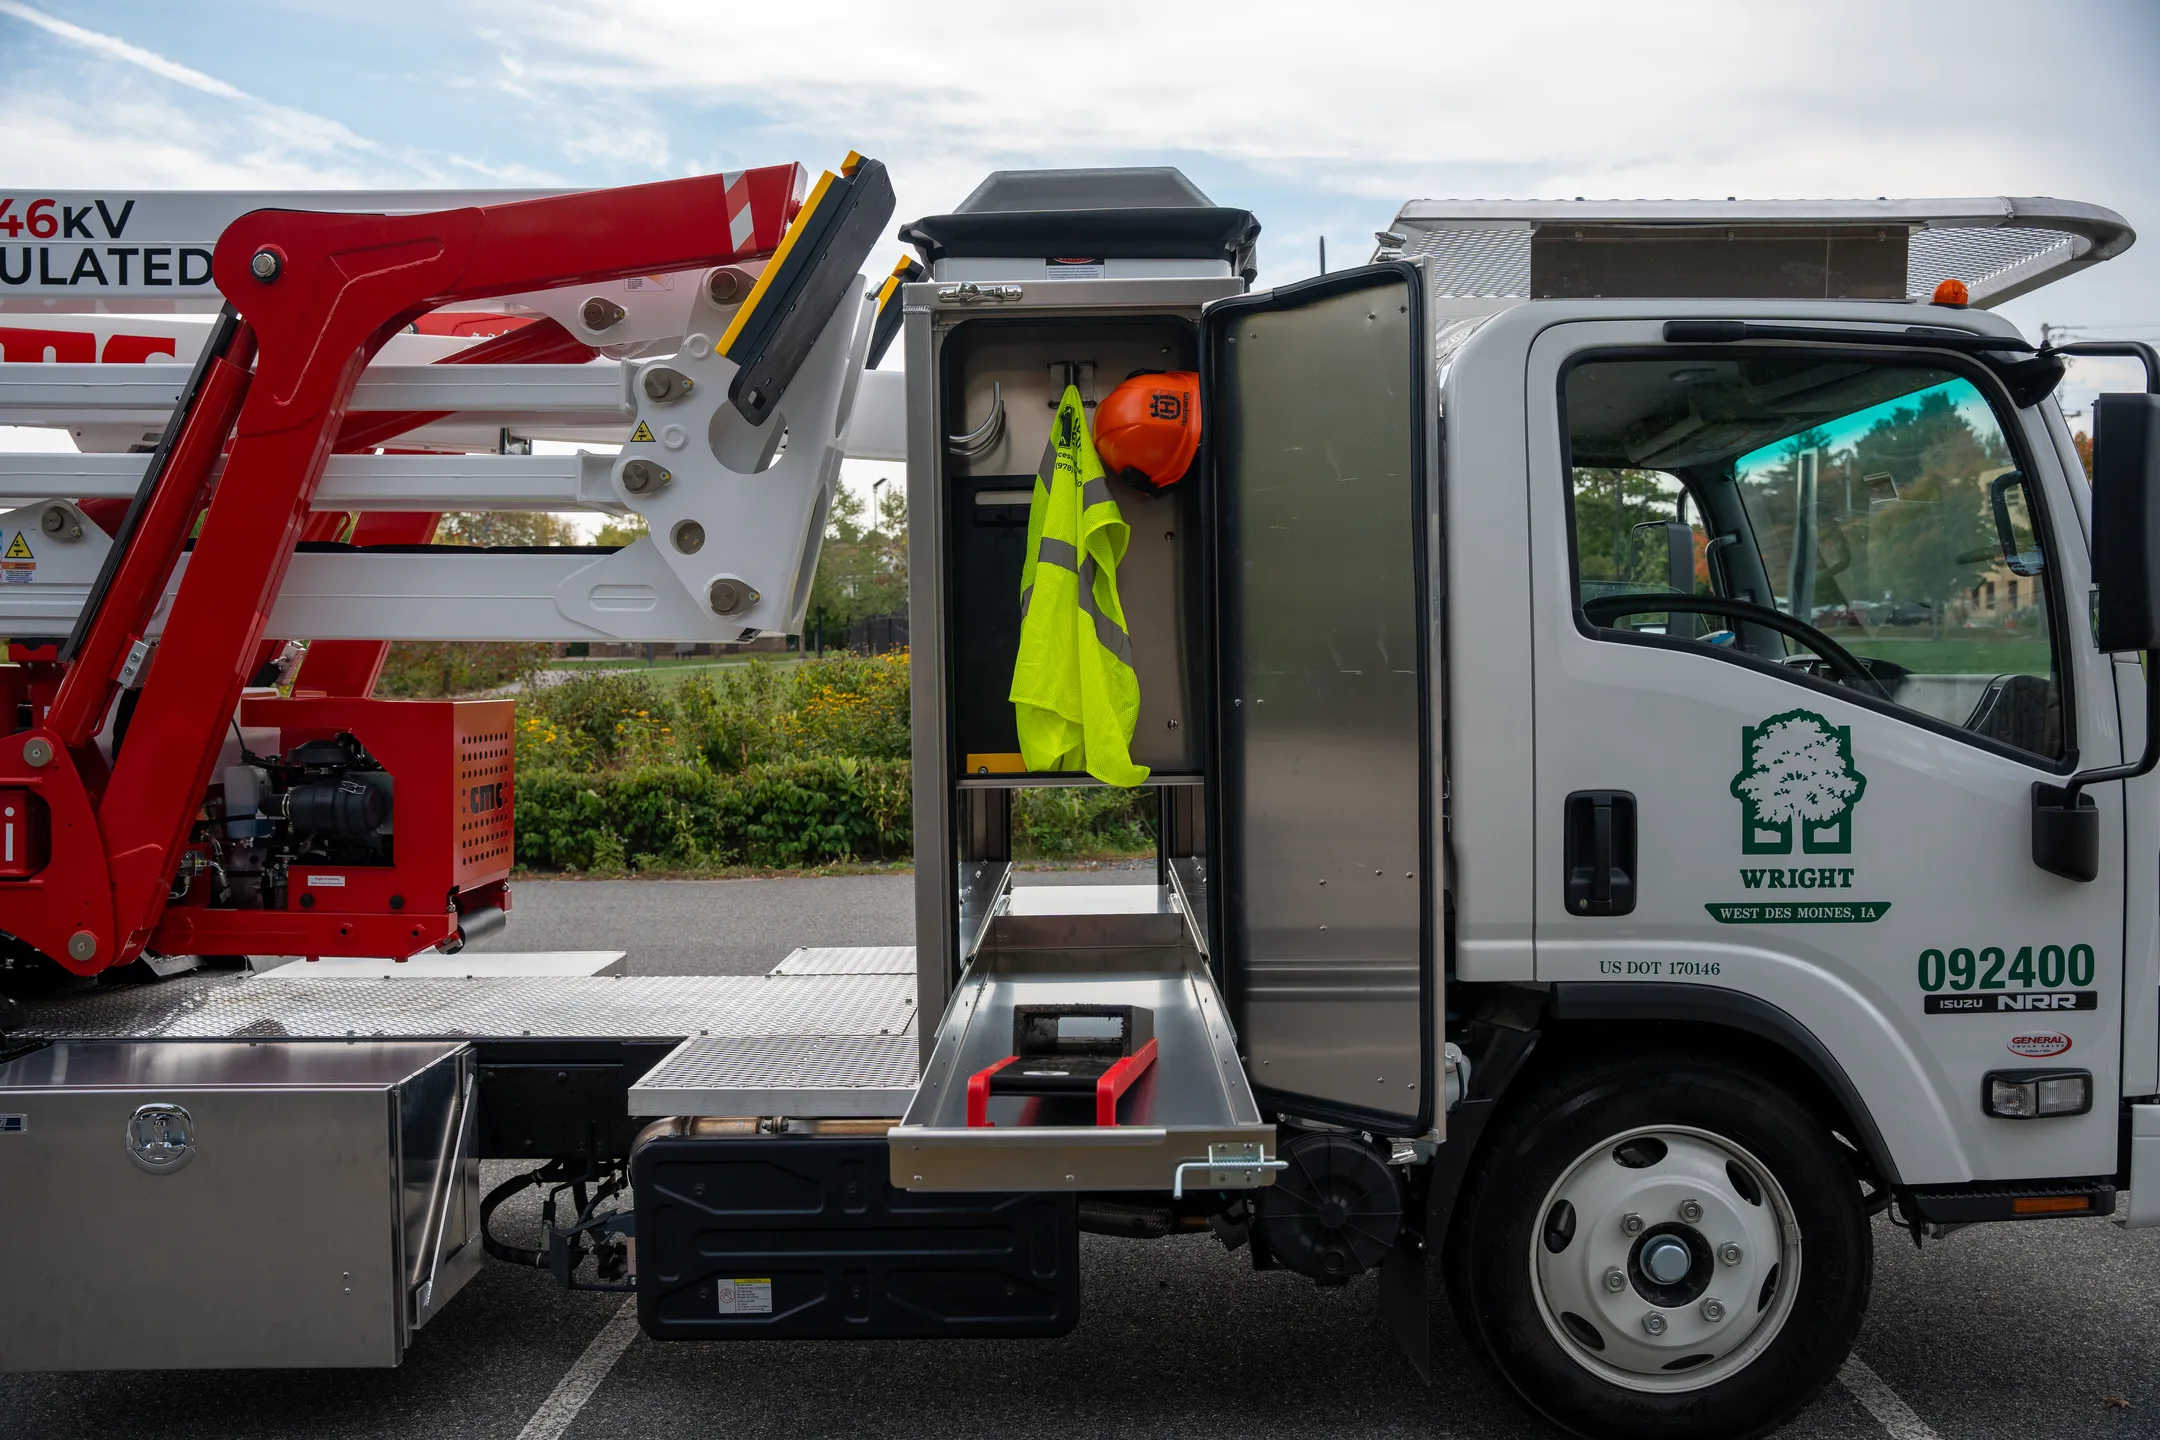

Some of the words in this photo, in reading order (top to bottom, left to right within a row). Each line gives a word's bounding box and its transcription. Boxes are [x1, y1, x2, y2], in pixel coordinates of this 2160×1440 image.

[1740, 868, 1854, 888] WRIGHT
[1720, 908, 1760, 919] WEST
[1765, 908, 1791, 918] DES
[1797, 907, 1855, 920] MOINES,
[1860, 907, 1876, 918] IA
[1600, 961, 1621, 974] US
[1626, 961, 1662, 974] DOT
[1669, 962, 1720, 975] 170146
[1917, 943, 2095, 992] 092400
[1940, 999, 1982, 1009] ISUZU
[1997, 994, 2076, 1010] NRR
[2012, 1036, 2064, 1044] GENERAL
